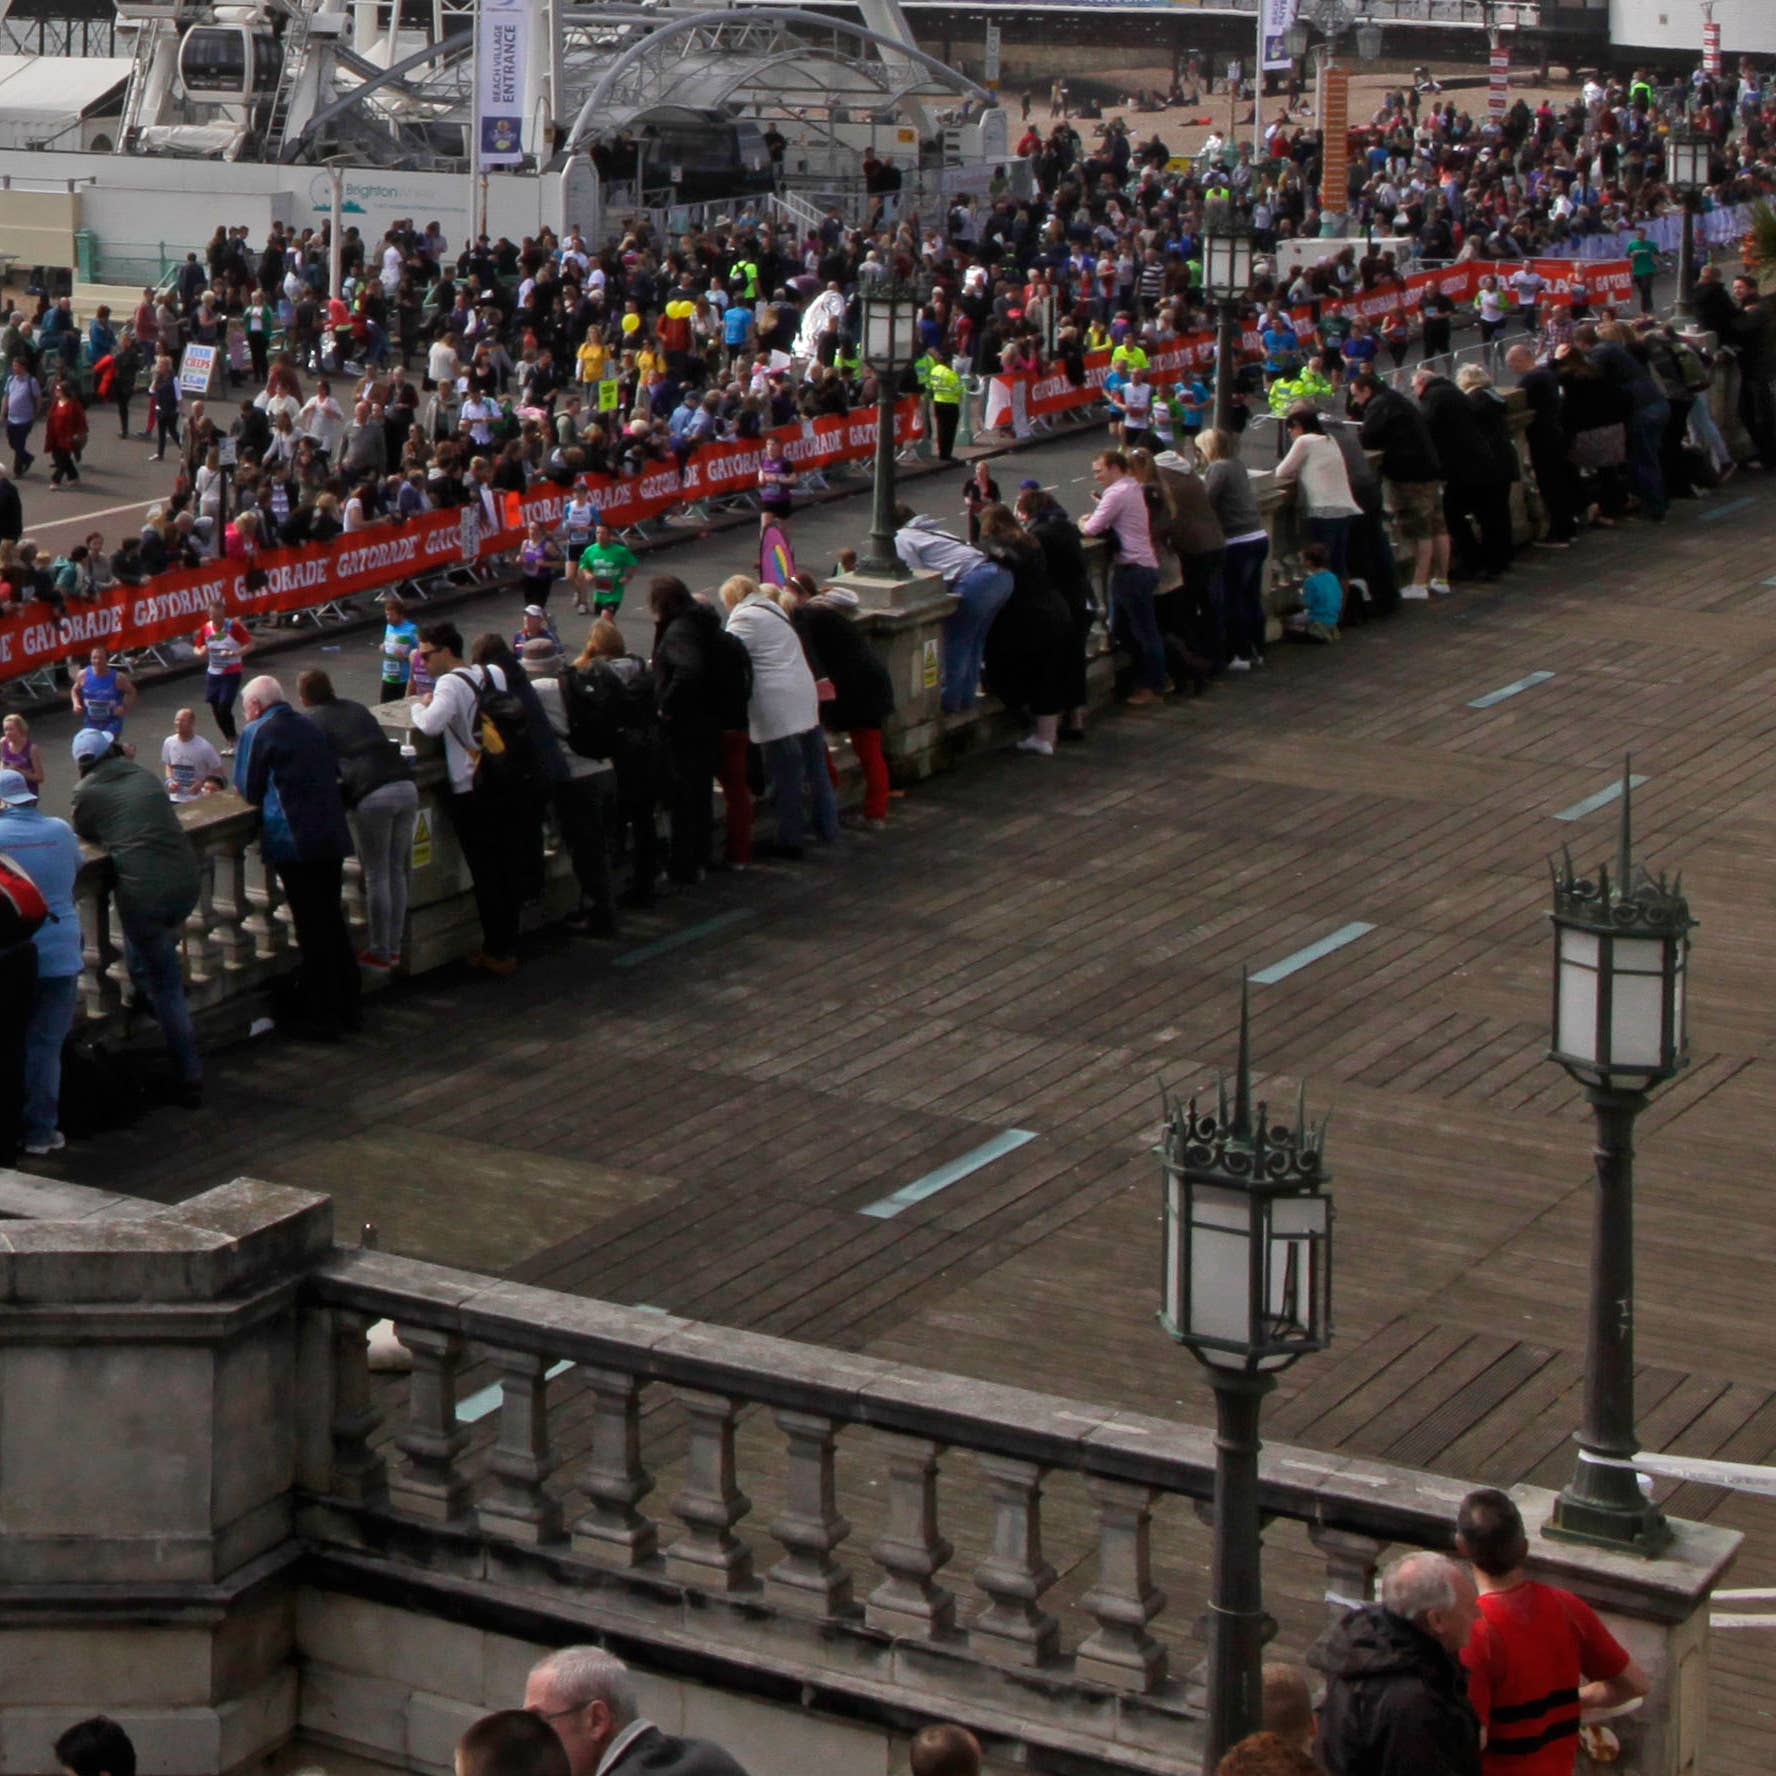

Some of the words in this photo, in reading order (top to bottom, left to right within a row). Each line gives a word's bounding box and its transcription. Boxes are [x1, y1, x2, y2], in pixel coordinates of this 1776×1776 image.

[493, 25, 503, 66] VILLAGE
[503, 25, 516, 103] ENTRANCE
[492, 69, 502, 102] BEACH
[346, 183, 397, 199] Brighton
[22, 597, 124, 660] GATORADE
[134, 579, 226, 626] GATORADE
[337, 538, 417, 577] GATORADE
